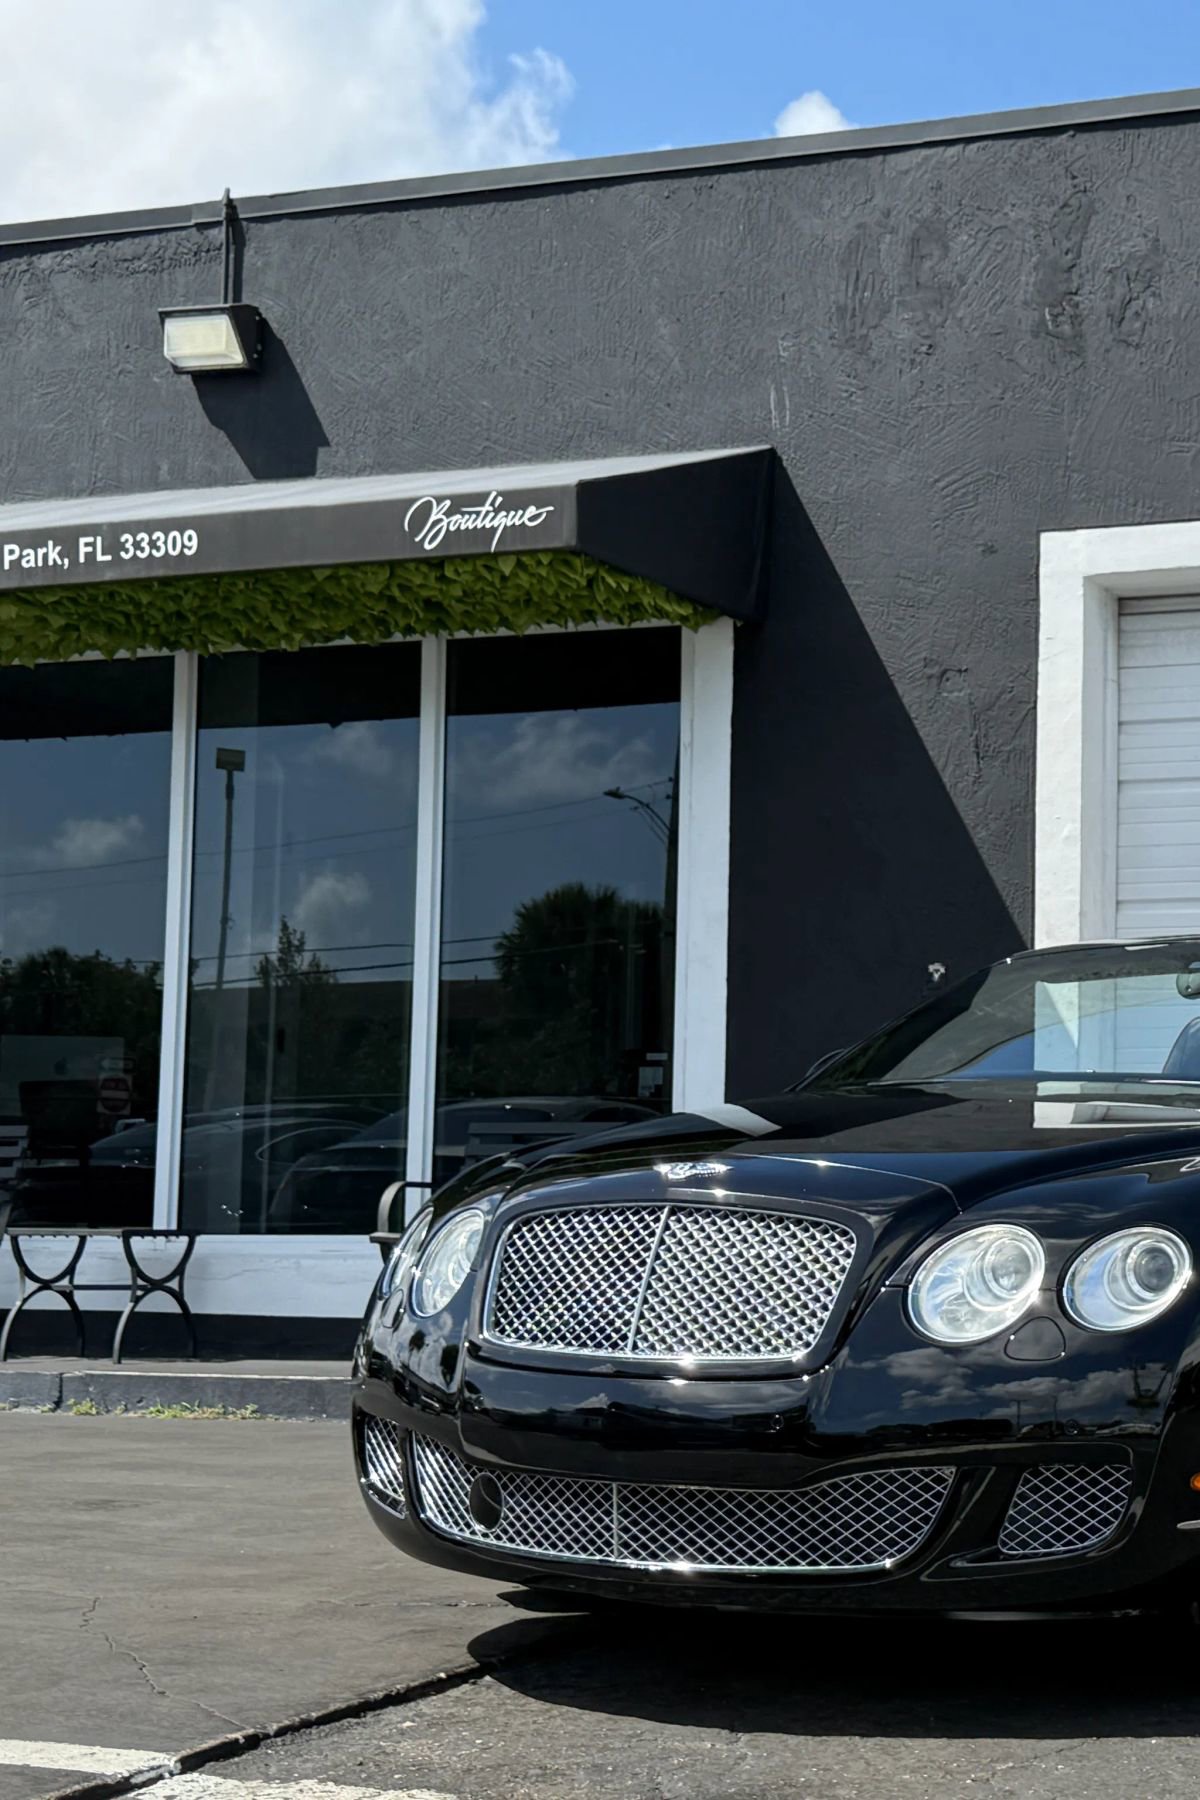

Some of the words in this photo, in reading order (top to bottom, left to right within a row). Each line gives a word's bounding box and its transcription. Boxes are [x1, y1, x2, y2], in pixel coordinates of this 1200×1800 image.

[404, 490, 555, 553] Boutique
[3, 540, 69, 570] Park,
[78, 536, 112, 563] FL
[119, 529, 198, 560] 33309
